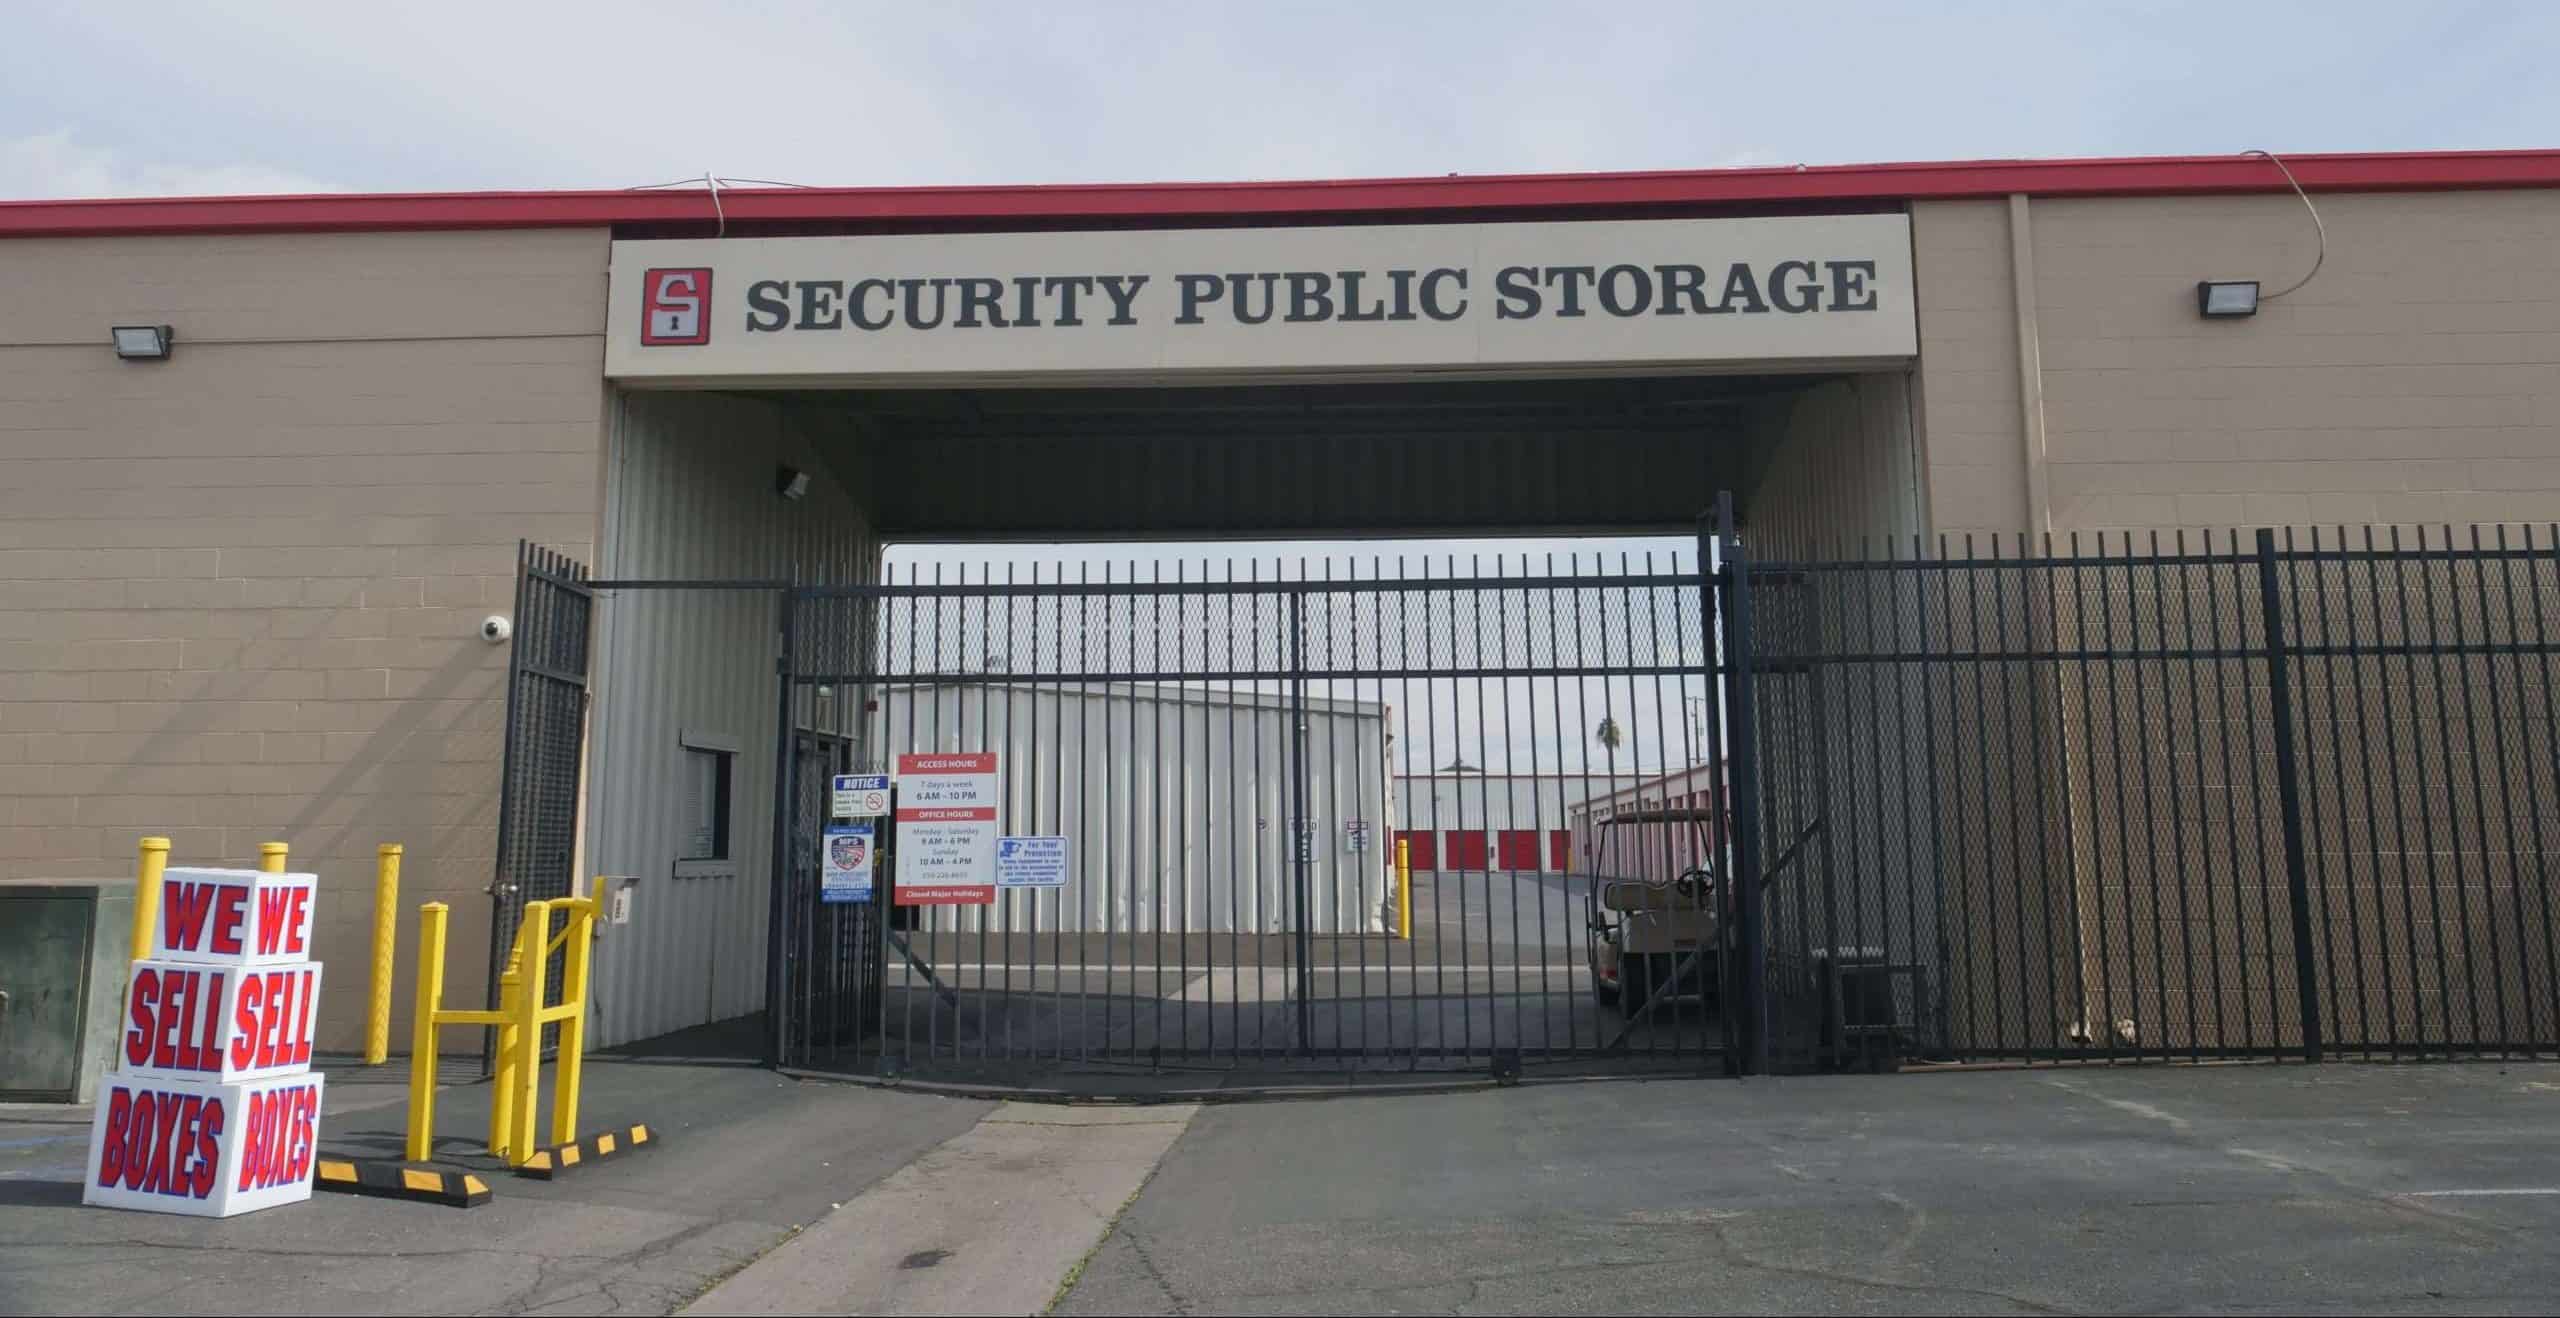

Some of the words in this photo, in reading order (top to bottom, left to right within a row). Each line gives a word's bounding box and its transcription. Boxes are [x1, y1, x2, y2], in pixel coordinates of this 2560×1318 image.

[746, 274, 1149, 333] SECURITY
[1174, 267, 1469, 325] PUBLIC
[1495, 260, 1878, 320] STORAGE
[844, 778, 880, 789] NOTICE
[917, 760, 947, 768] ACCESS
[948, 760, 976, 768] HOURS
[917, 792, 922, 801] 6
[924, 792, 940, 800] AM
[950, 792, 960, 800] 10
[962, 791, 976, 800] PM
[927, 779, 944, 790] days
[953, 779, 973, 788] week
[163, 881, 247, 954] WE
[257, 885, 310, 955] WE
[126, 967, 225, 1073] SELL
[231, 968, 314, 1070] SELL
[98, 1086, 226, 1199] BOXES
[237, 1084, 318, 1193] BOXES
